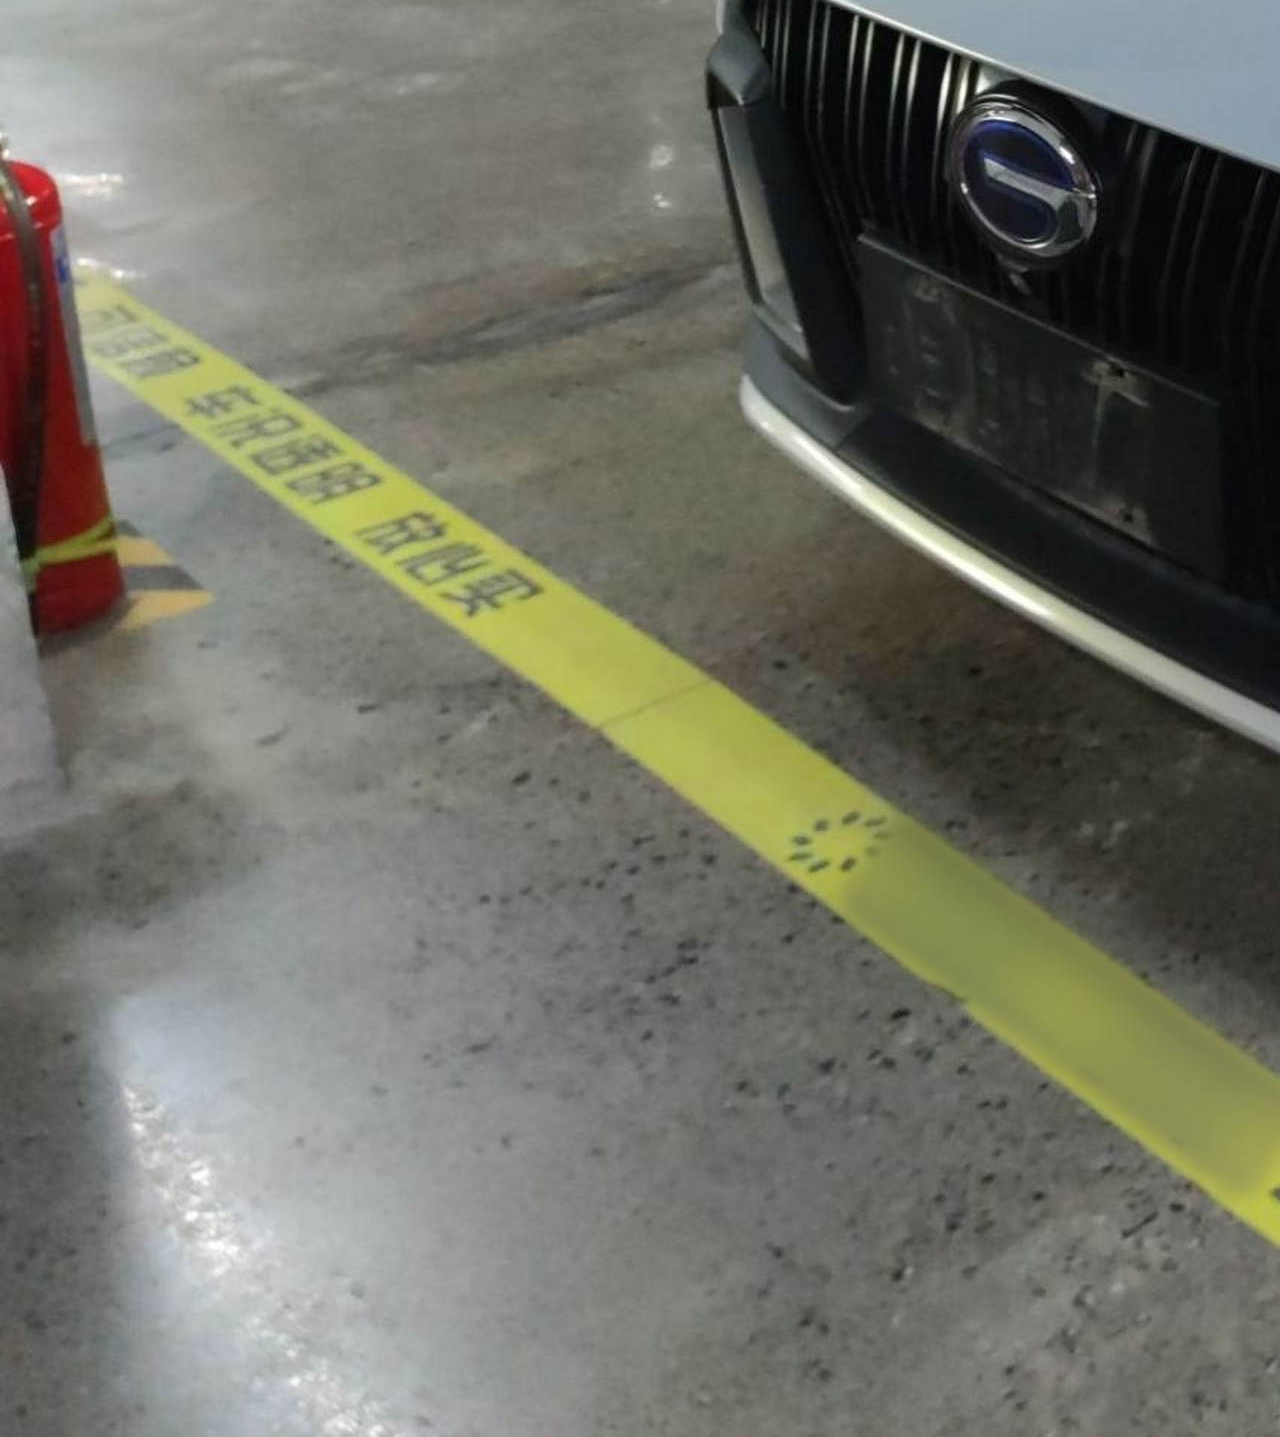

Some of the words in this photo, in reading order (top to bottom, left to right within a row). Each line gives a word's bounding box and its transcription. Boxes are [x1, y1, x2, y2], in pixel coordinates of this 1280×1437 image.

[184, 384, 384, 506] 车况透明
[353, 512, 544, 618] 放心买
